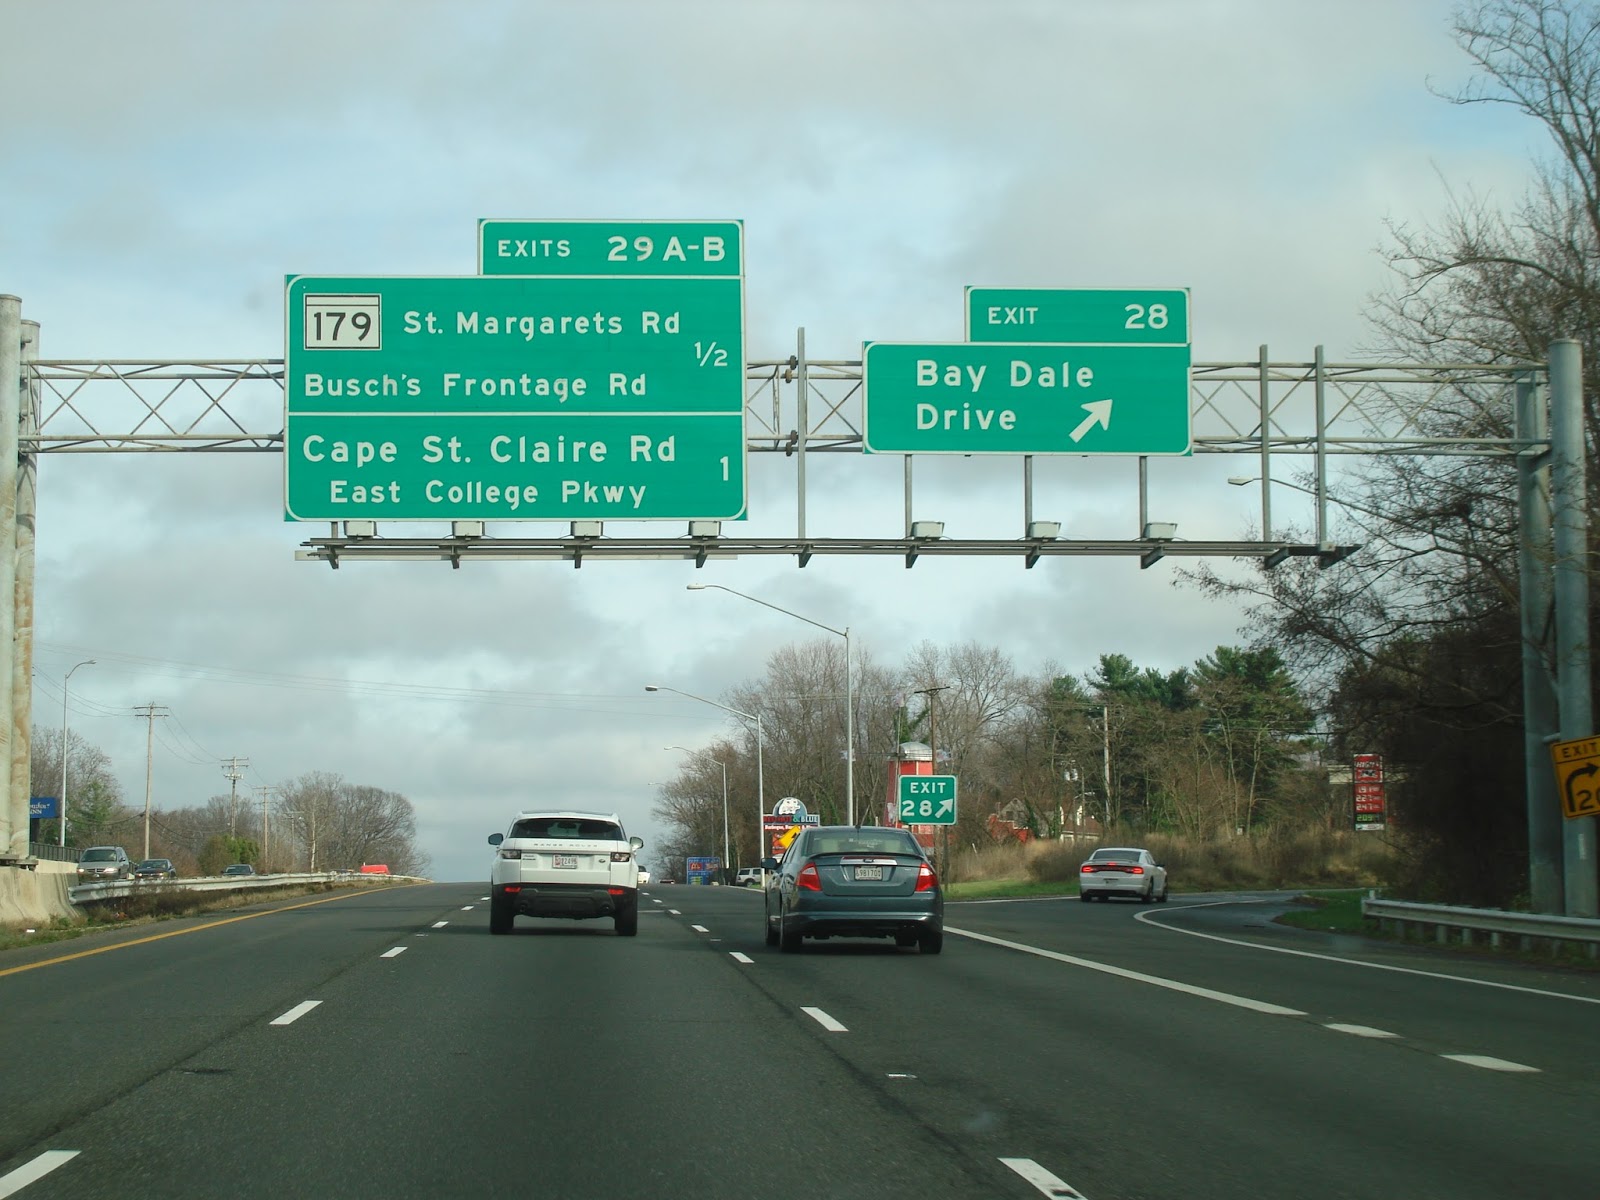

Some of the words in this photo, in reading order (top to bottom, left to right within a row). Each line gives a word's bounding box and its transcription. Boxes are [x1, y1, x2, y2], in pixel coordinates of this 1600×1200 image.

[498, 239, 571, 257] EXITS
[607, 236, 653, 261] 29
[662, 236, 725, 262] A-B
[313, 312, 371, 341] 179
[403, 311, 443, 334] St.
[457, 311, 622, 341] Margarets
[642, 311, 679, 334] Rd
[988, 307, 1038, 324] EXIT
[1125, 304, 1168, 329] 28
[305, 373, 421, 396] Busch's
[443, 373, 587, 402] Frontage
[609, 373, 646, 396] Rd
[917, 359, 987, 392] Bay
[1010, 360, 1094, 388] Dale
[917, 402, 1016, 430] Drive
[303, 434, 397, 467] Cape
[422, 435, 471, 463] St.
[490, 435, 607, 462] Claire
[630, 435, 675, 462] Rd
[720, 456, 729, 481] 1
[330, 480, 400, 503] East
[425, 480, 538, 510] College
[562, 480, 646, 509] Pkwy
[1561, 741, 1597, 758] EXIT
[910, 782, 946, 794] EXIT
[901, 799, 933, 817] 28
